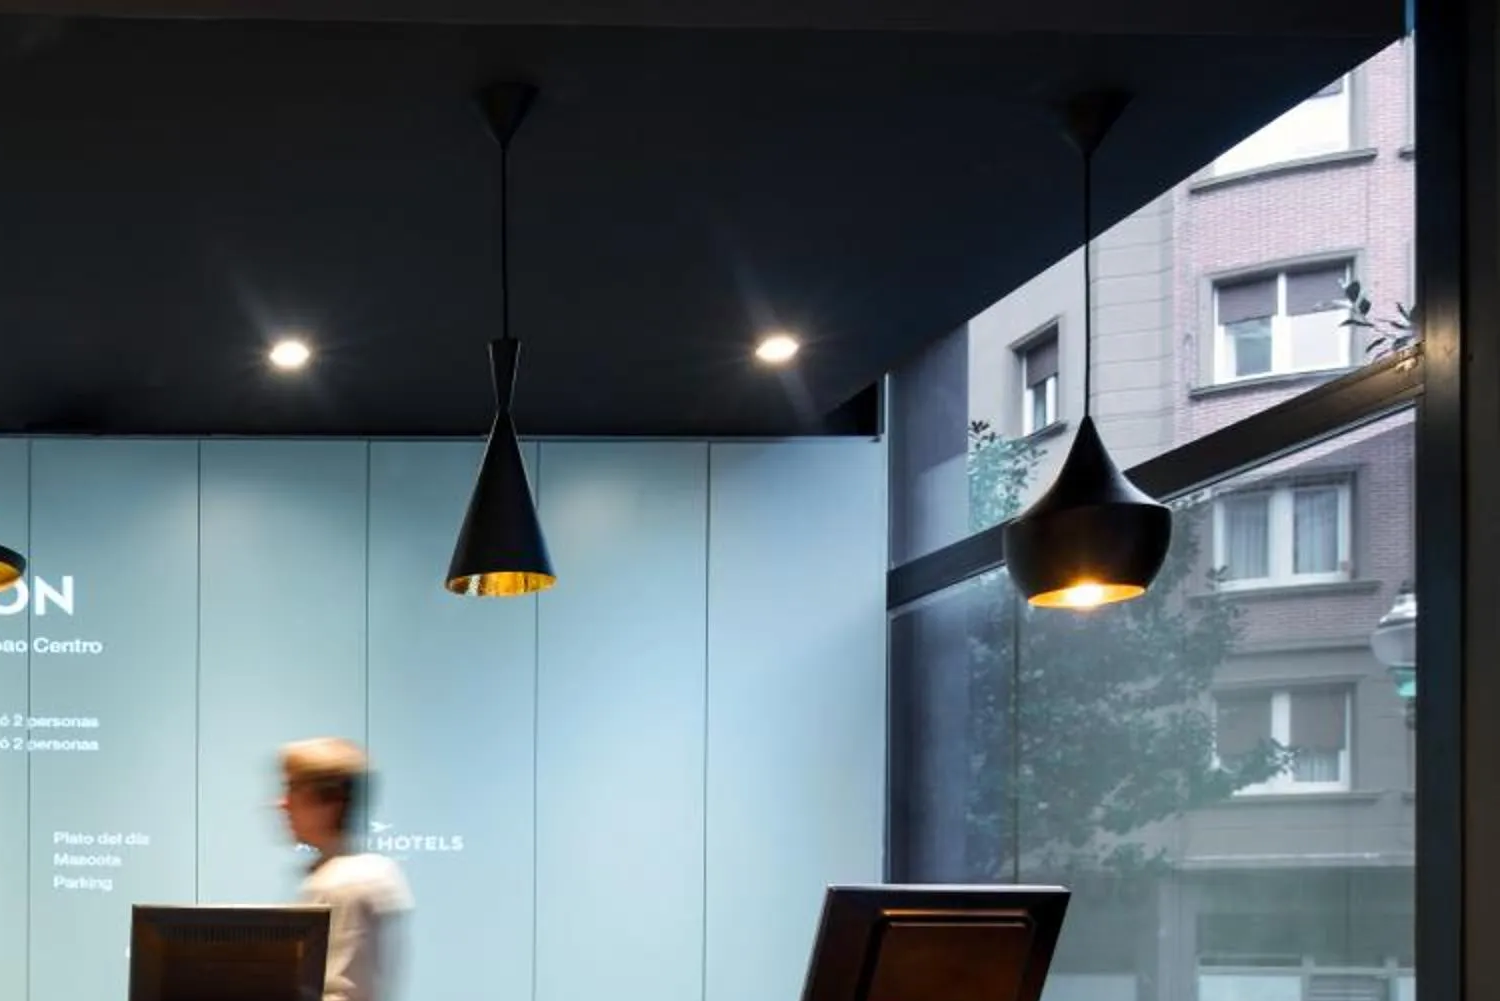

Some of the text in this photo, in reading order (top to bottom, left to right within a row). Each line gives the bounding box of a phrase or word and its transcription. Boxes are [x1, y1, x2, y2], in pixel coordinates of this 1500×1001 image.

[33, 637, 103, 654] Centro
[13, 714, 23, 727] 2
[13, 737, 24, 750] 2
[53, 831, 95, 845] Plato
[98, 832, 122, 845] del
[377, 835, 464, 851] HOTELS
[53, 876, 113, 891] Parking
